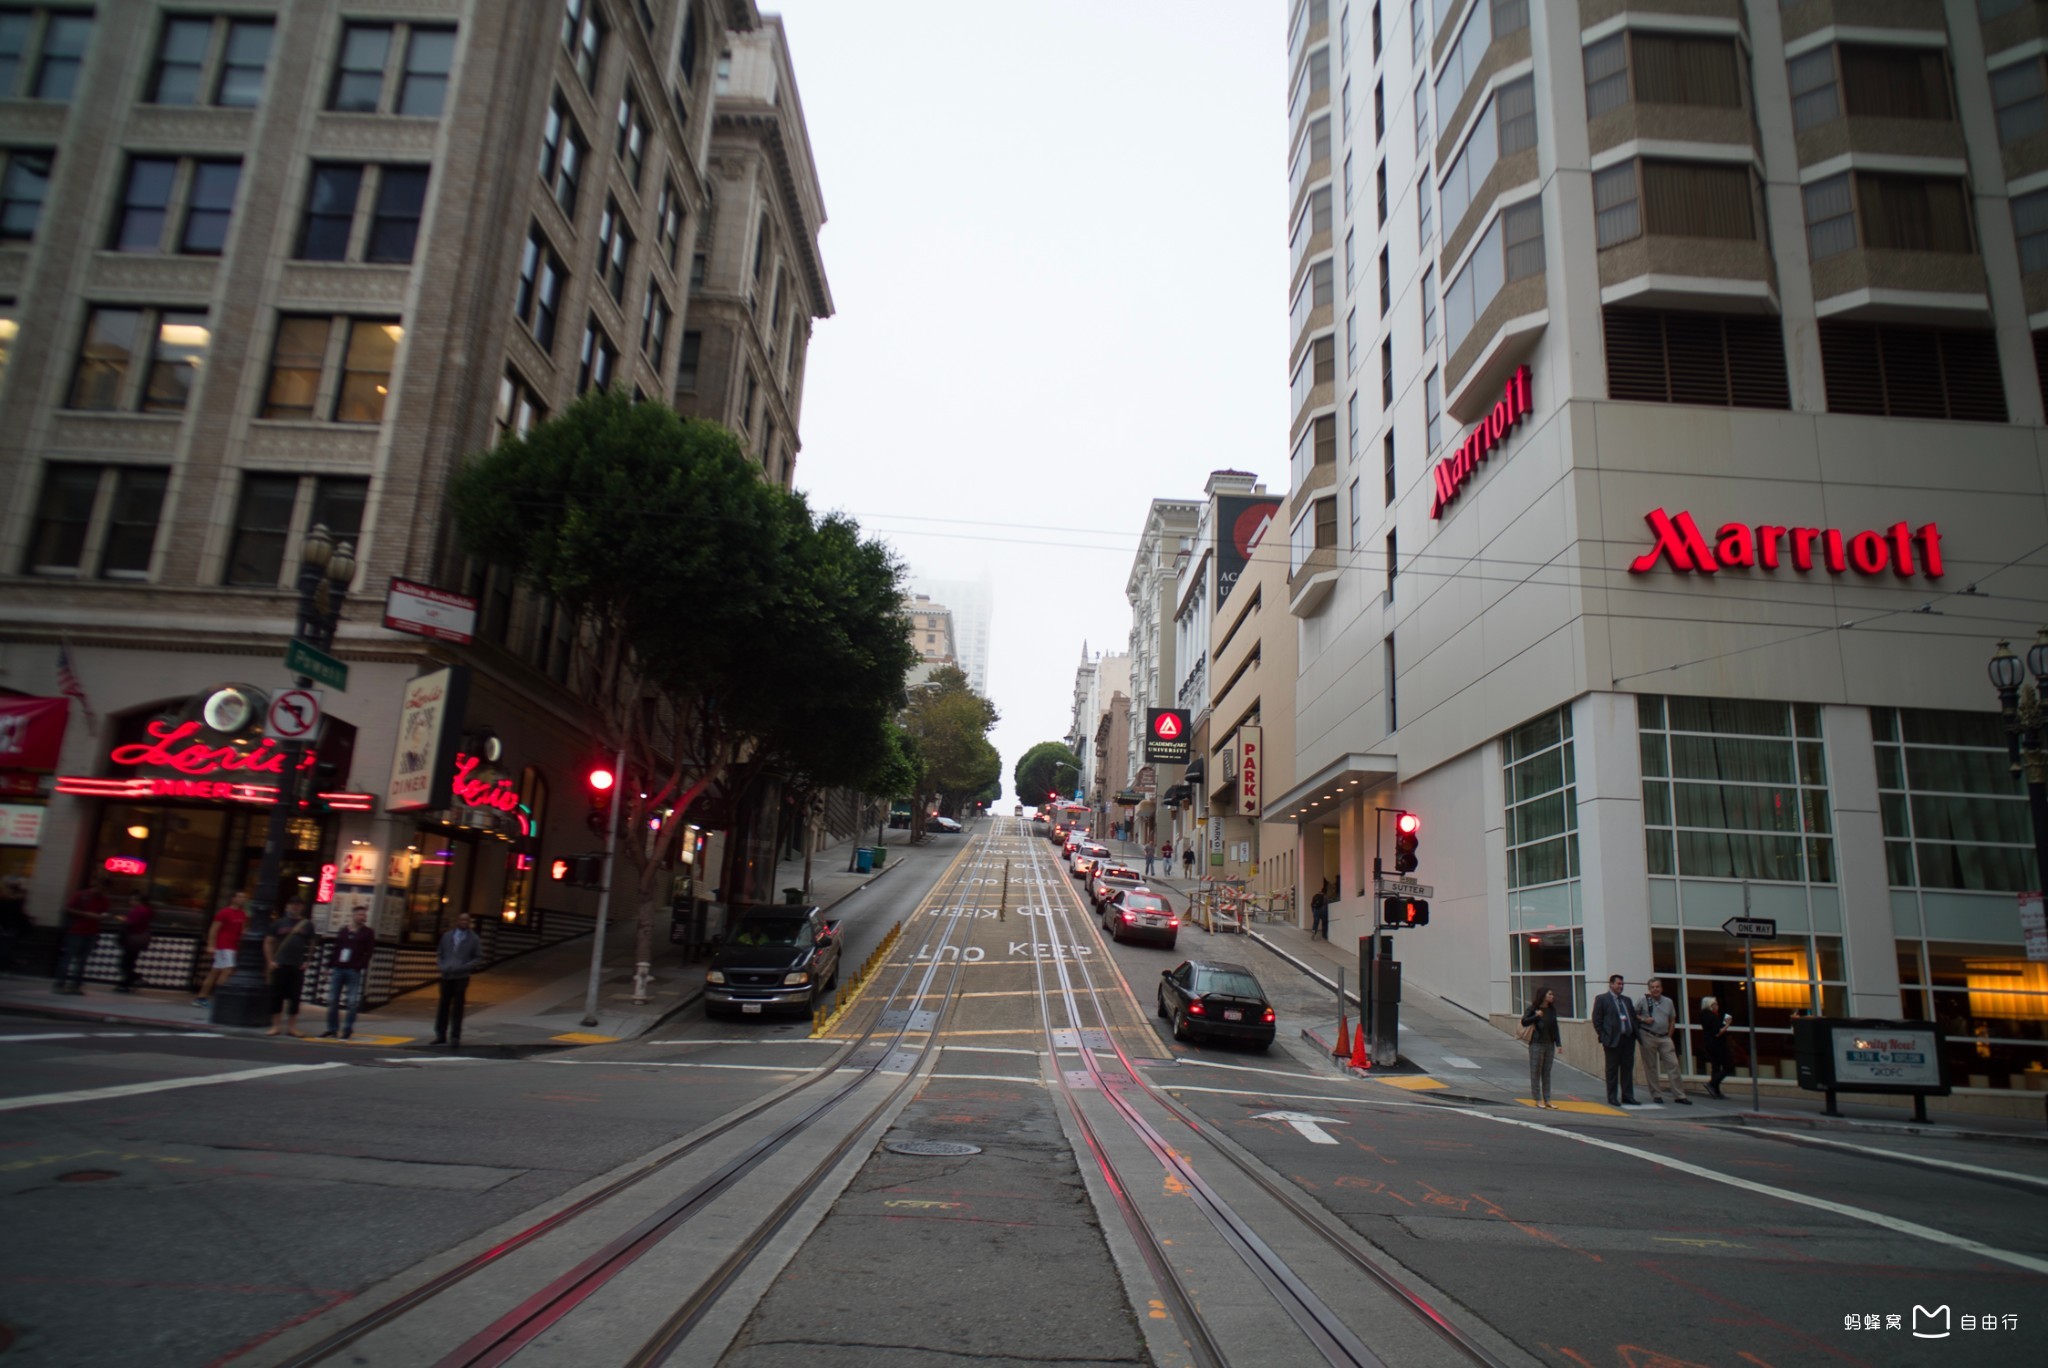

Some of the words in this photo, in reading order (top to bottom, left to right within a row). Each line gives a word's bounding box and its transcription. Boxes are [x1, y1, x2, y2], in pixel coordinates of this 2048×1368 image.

[1430, 364, 1534, 520] Marriott
[1628, 507, 1944, 579] Marriott
[1220, 571, 1241, 582] AC
[1244, 743, 1256, 797] PARK
[151, 779, 232, 799] DINER
[392, 776, 427, 795] DINER
[104, 857, 141, 873] OPEN
[954, 877, 998, 885] OUT
[1009, 877, 1060, 885] KEEP
[1391, 883, 1425, 895] SUTTER
[929, 907, 998, 919] KEEP
[1016, 907, 1069, 919] OUT
[1738, 924, 1753, 932] ONE
[1755, 925, 1770, 933] WAY
[909, 943, 985, 961] OUT
[1008, 941, 1093, 960] KEEP
